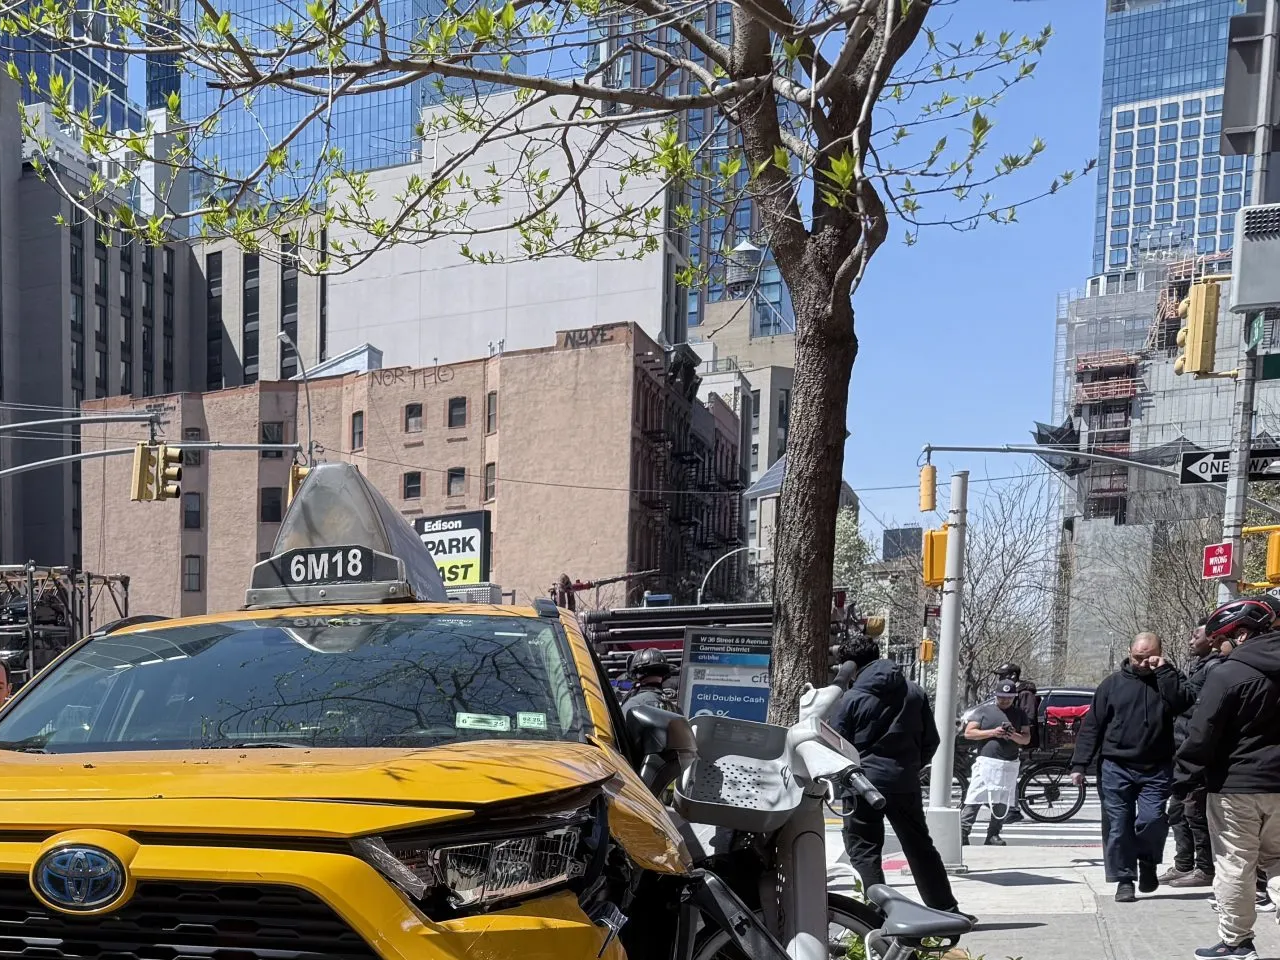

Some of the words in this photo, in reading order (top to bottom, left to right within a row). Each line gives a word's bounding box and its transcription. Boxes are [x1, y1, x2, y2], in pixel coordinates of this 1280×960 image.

[1198, 460, 1229, 474] ONE
[1249, 457, 1277, 475] WA
[424, 519, 462, 532] Edison
[424, 535, 476, 555] PARK
[289, 548, 363, 582] 6M18
[1209, 555, 1228, 566] WRONG
[438, 563, 473, 582] AST
[1212, 565, 1225, 574] WAY
[696, 693, 711, 701] Citi
[712, 694, 742, 702] Double
[742, 695, 765, 703] Cash
